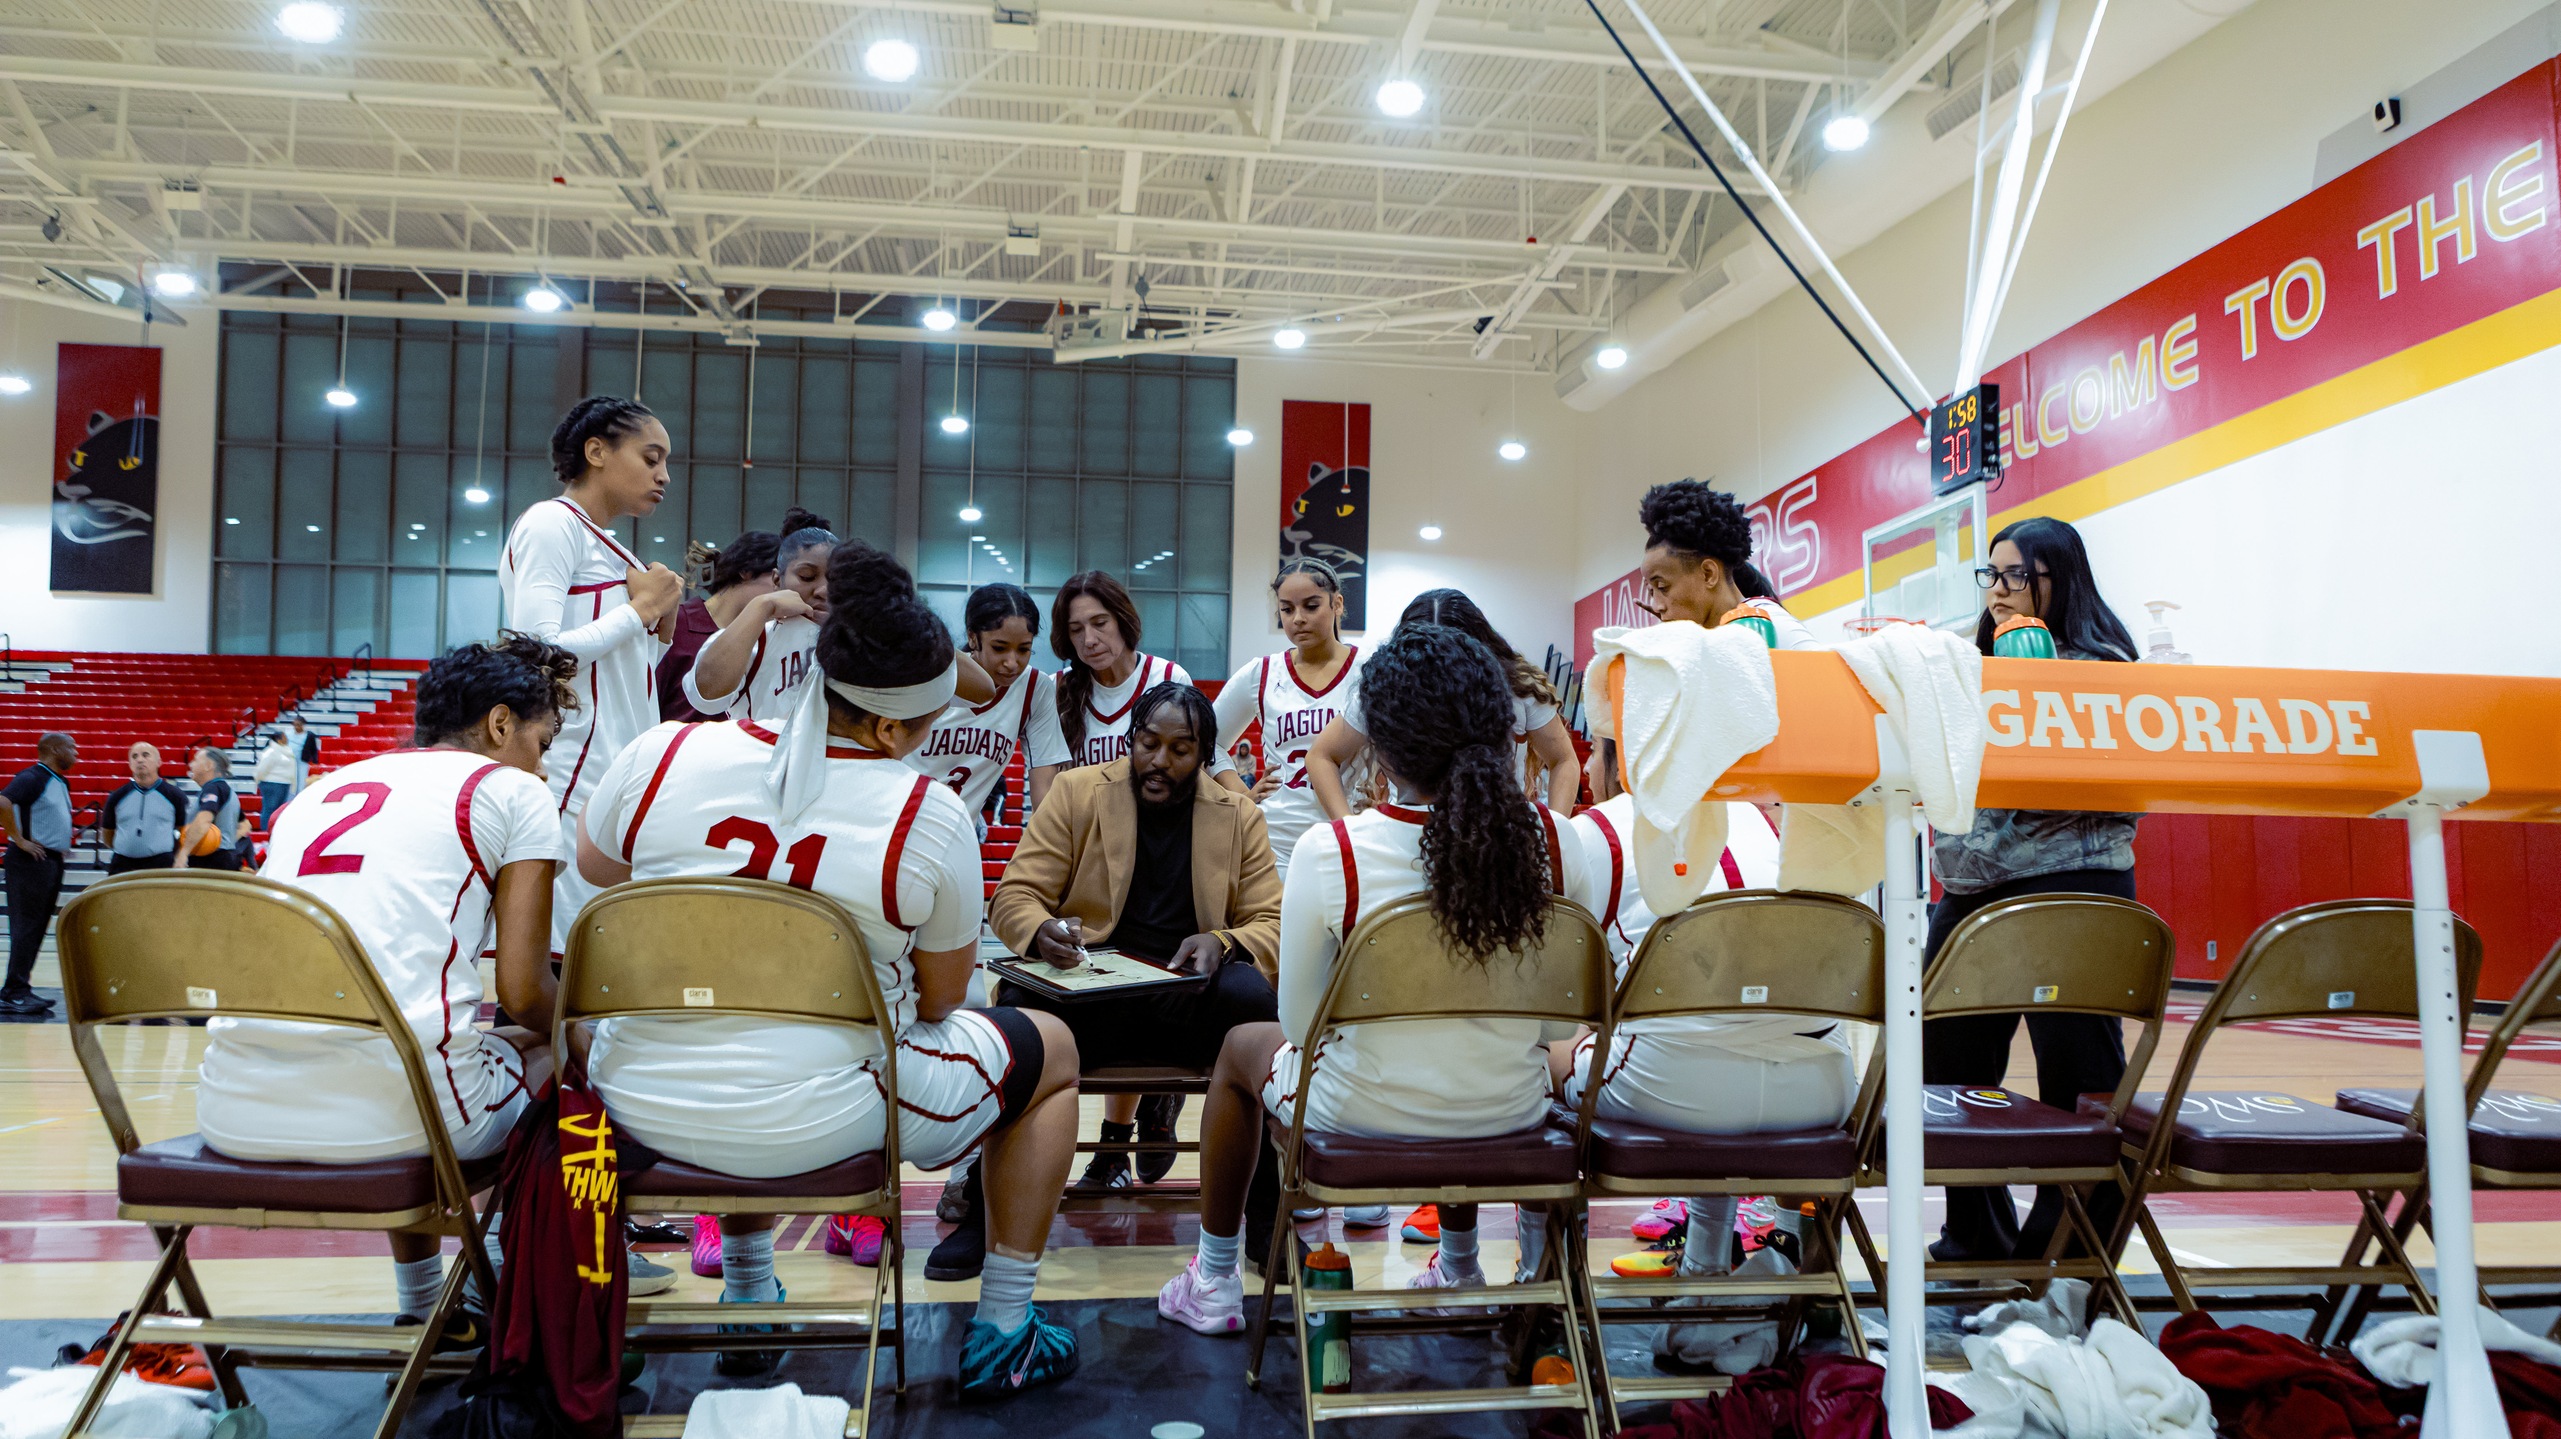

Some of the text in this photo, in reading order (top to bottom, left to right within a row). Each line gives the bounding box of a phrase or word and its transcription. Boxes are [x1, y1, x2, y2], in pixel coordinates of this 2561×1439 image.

[1999, 138, 2547, 471] ELCOME TO THE
[1948, 394, 1977, 430] 1:58
[1942, 427, 1971, 483] 30
[921, 727, 1012, 766] JAGUARS
[1275, 708, 1336, 748] JAGUA
[1981, 689, 2379, 756] GATORADE
[296, 781, 392, 878] 2
[704, 815, 828, 891] 21
[562, 1165, 618, 1203] THW
